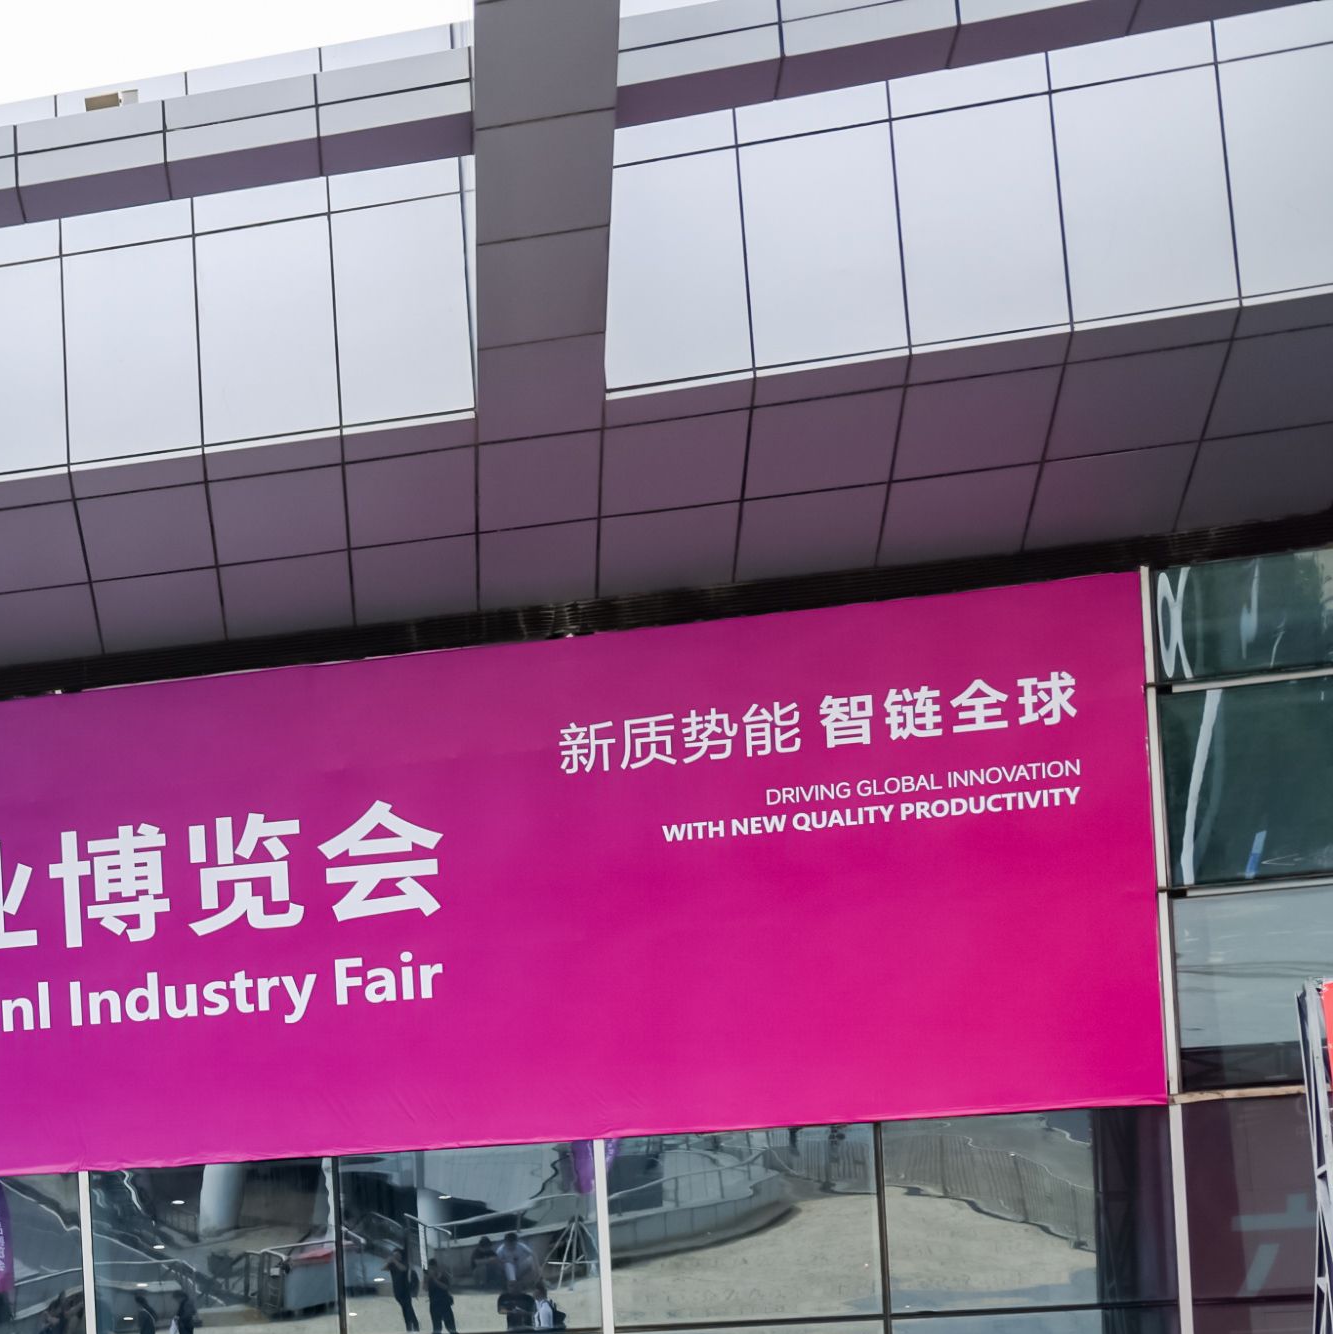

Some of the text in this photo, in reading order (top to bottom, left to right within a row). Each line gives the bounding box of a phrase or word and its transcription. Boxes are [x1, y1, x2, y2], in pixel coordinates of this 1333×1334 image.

[558, 671, 1078, 775] 新质势能 智链全球
[661, 786, 1081, 842] WITH NEW QUALITY PRODUCTIVITY
[766, 758, 1081, 806] DRIVING GLOBAL INNOVATION
[69, 970, 317, 1027] Industry
[334, 951, 443, 1005] Fair
